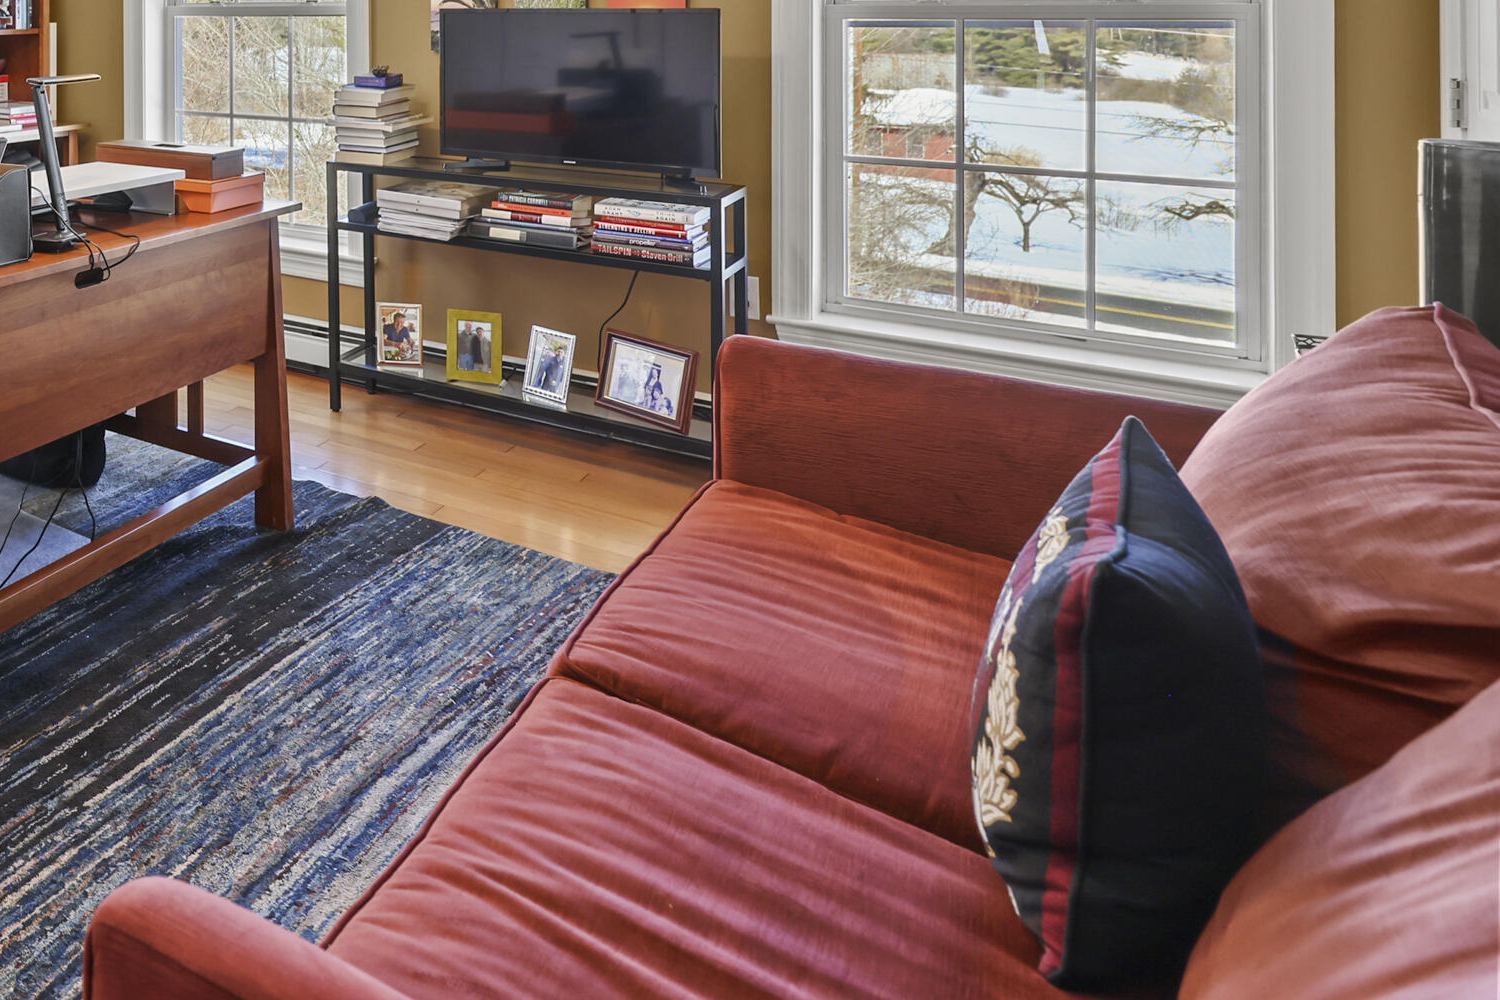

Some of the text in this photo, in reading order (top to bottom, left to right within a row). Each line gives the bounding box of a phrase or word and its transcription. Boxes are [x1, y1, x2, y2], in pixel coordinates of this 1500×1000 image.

[628, 239, 657, 247] propeller
[597, 244, 632, 257] TAILSPIN
[641, 249, 667, 261] Steven
